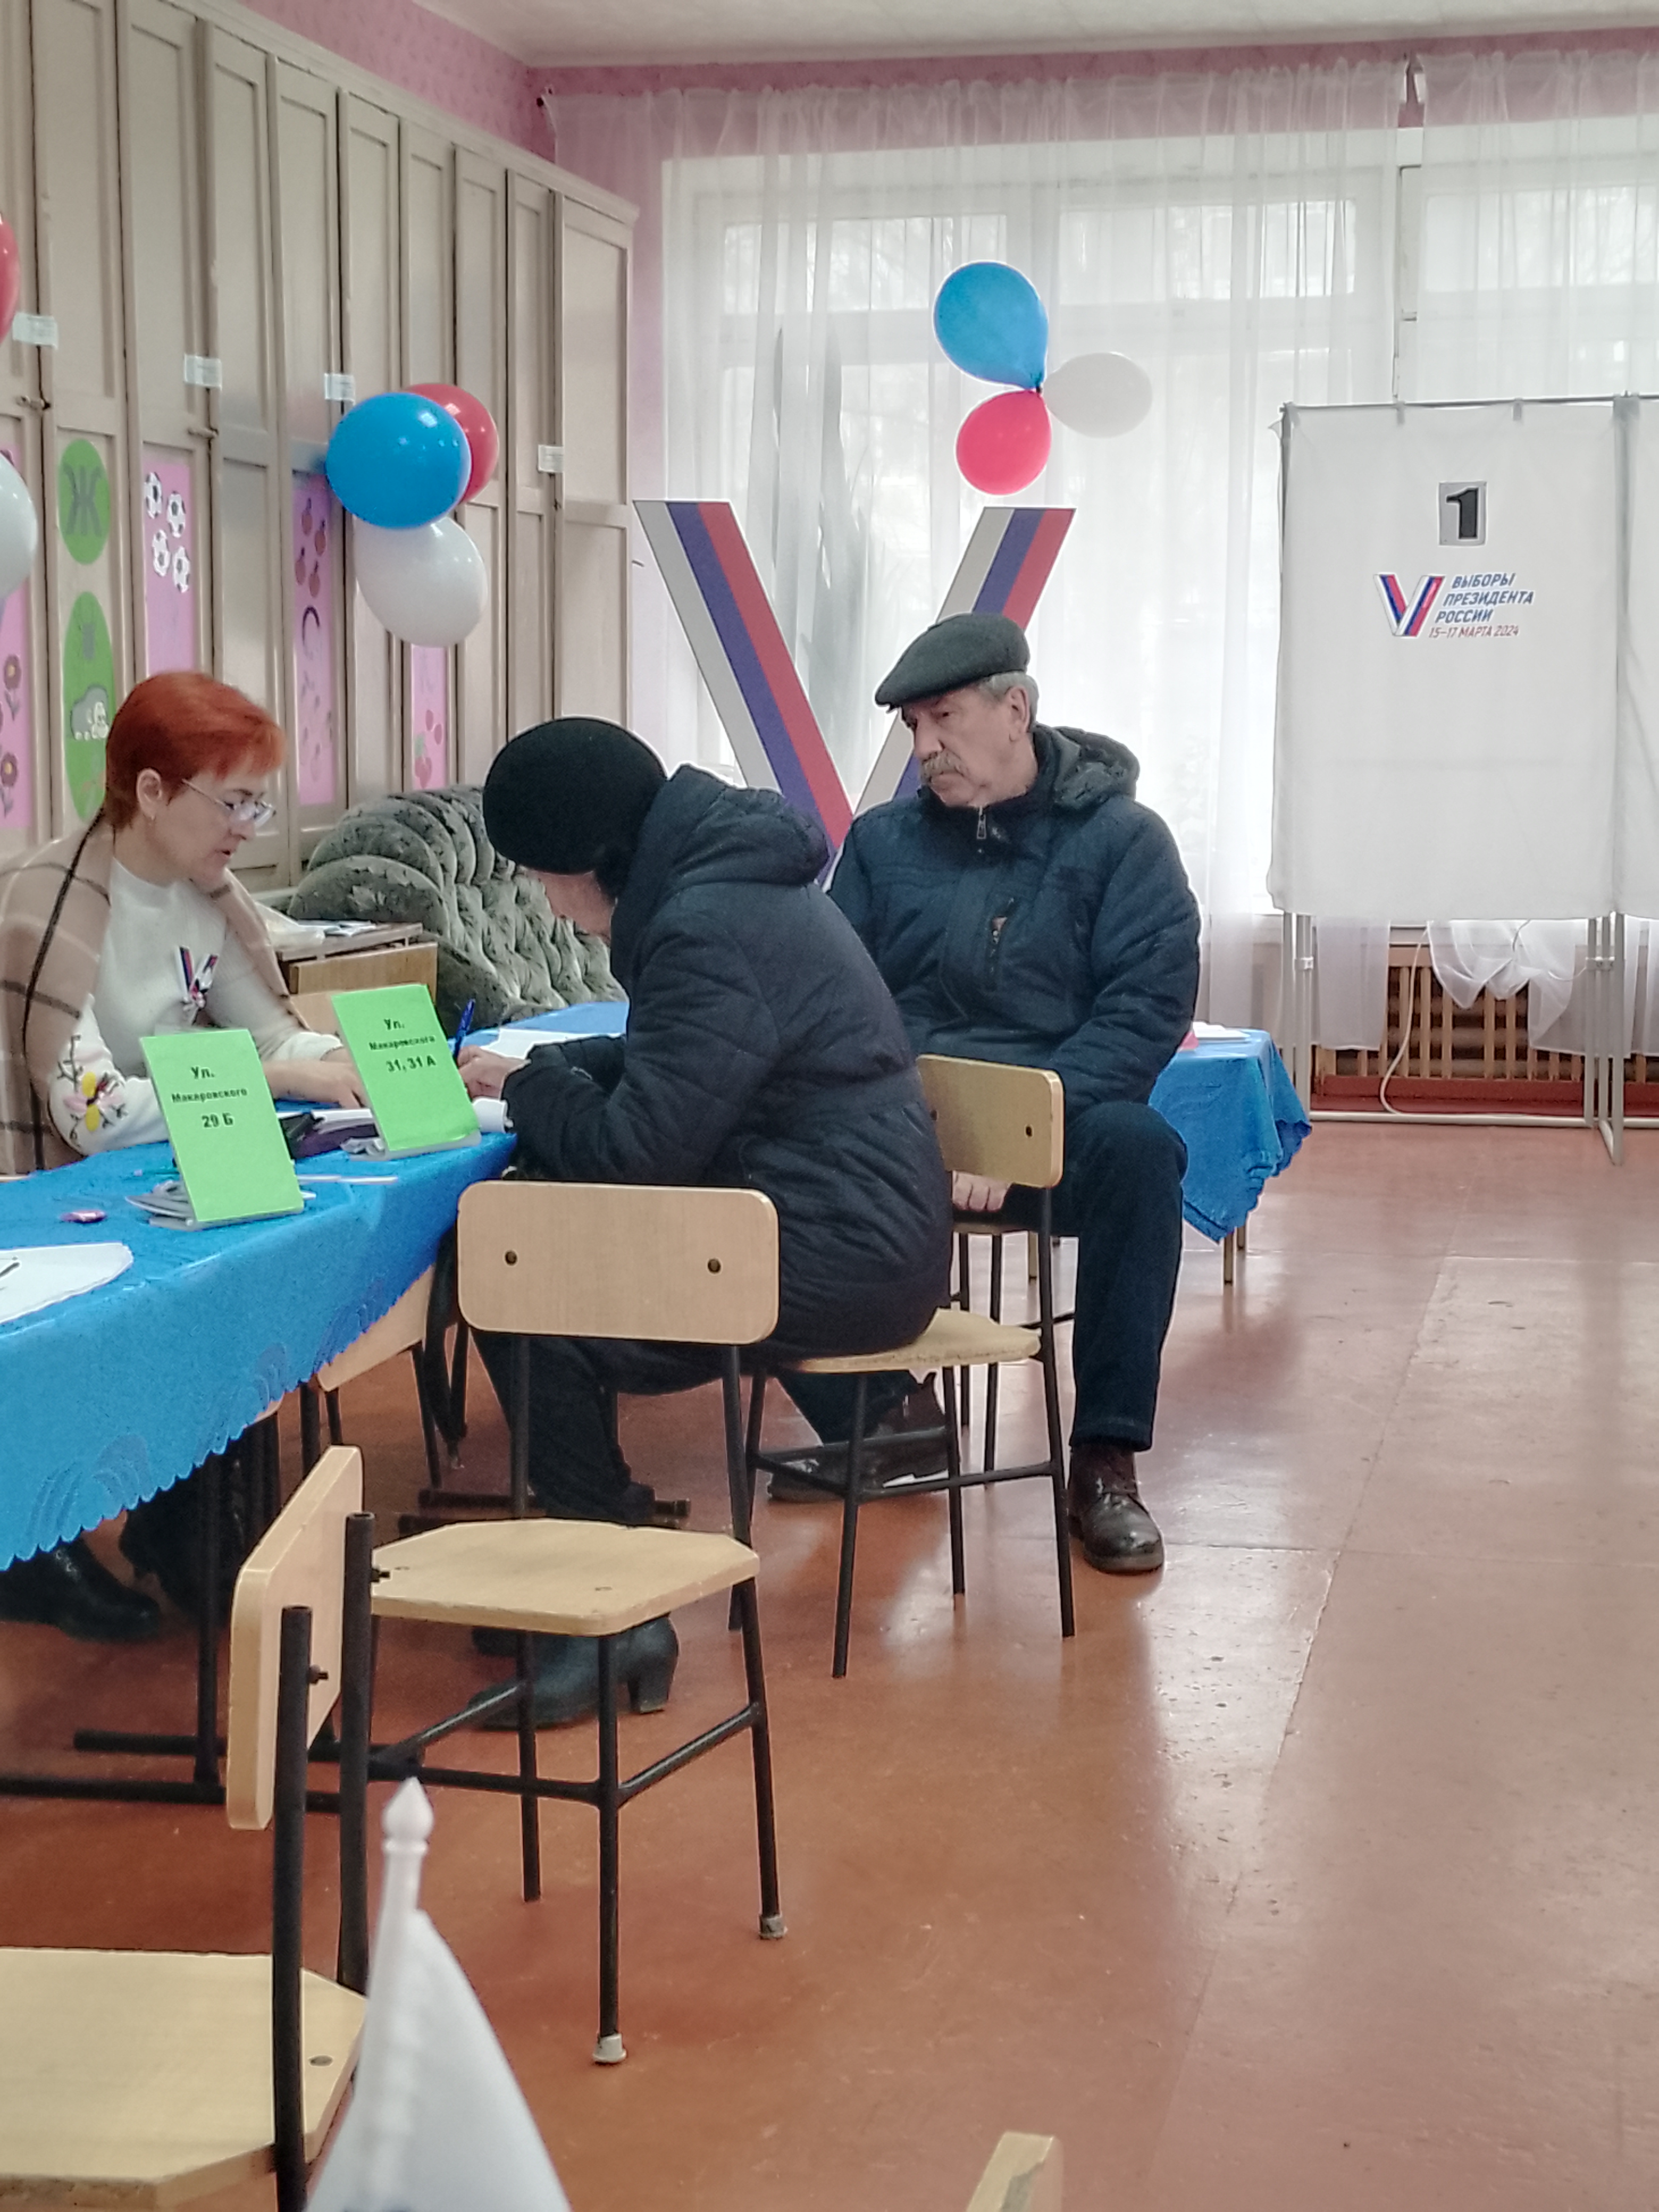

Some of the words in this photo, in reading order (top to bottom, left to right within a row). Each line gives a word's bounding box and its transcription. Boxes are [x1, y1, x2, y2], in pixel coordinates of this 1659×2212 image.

[1446, 487, 1479, 539] 1
[1451, 573, 1516, 589] ВЫБОРЫ
[1443, 590, 1535, 606] ПРЕЗИДЕНТА
[1435, 608, 1494, 623] РОССИИ
[1458, 626, 1493, 638] МАРТА
[1493, 625, 1520, 636] 2024
[383, 1018, 405, 1030] Ул.
[191, 1066, 215, 1079] Ул.
